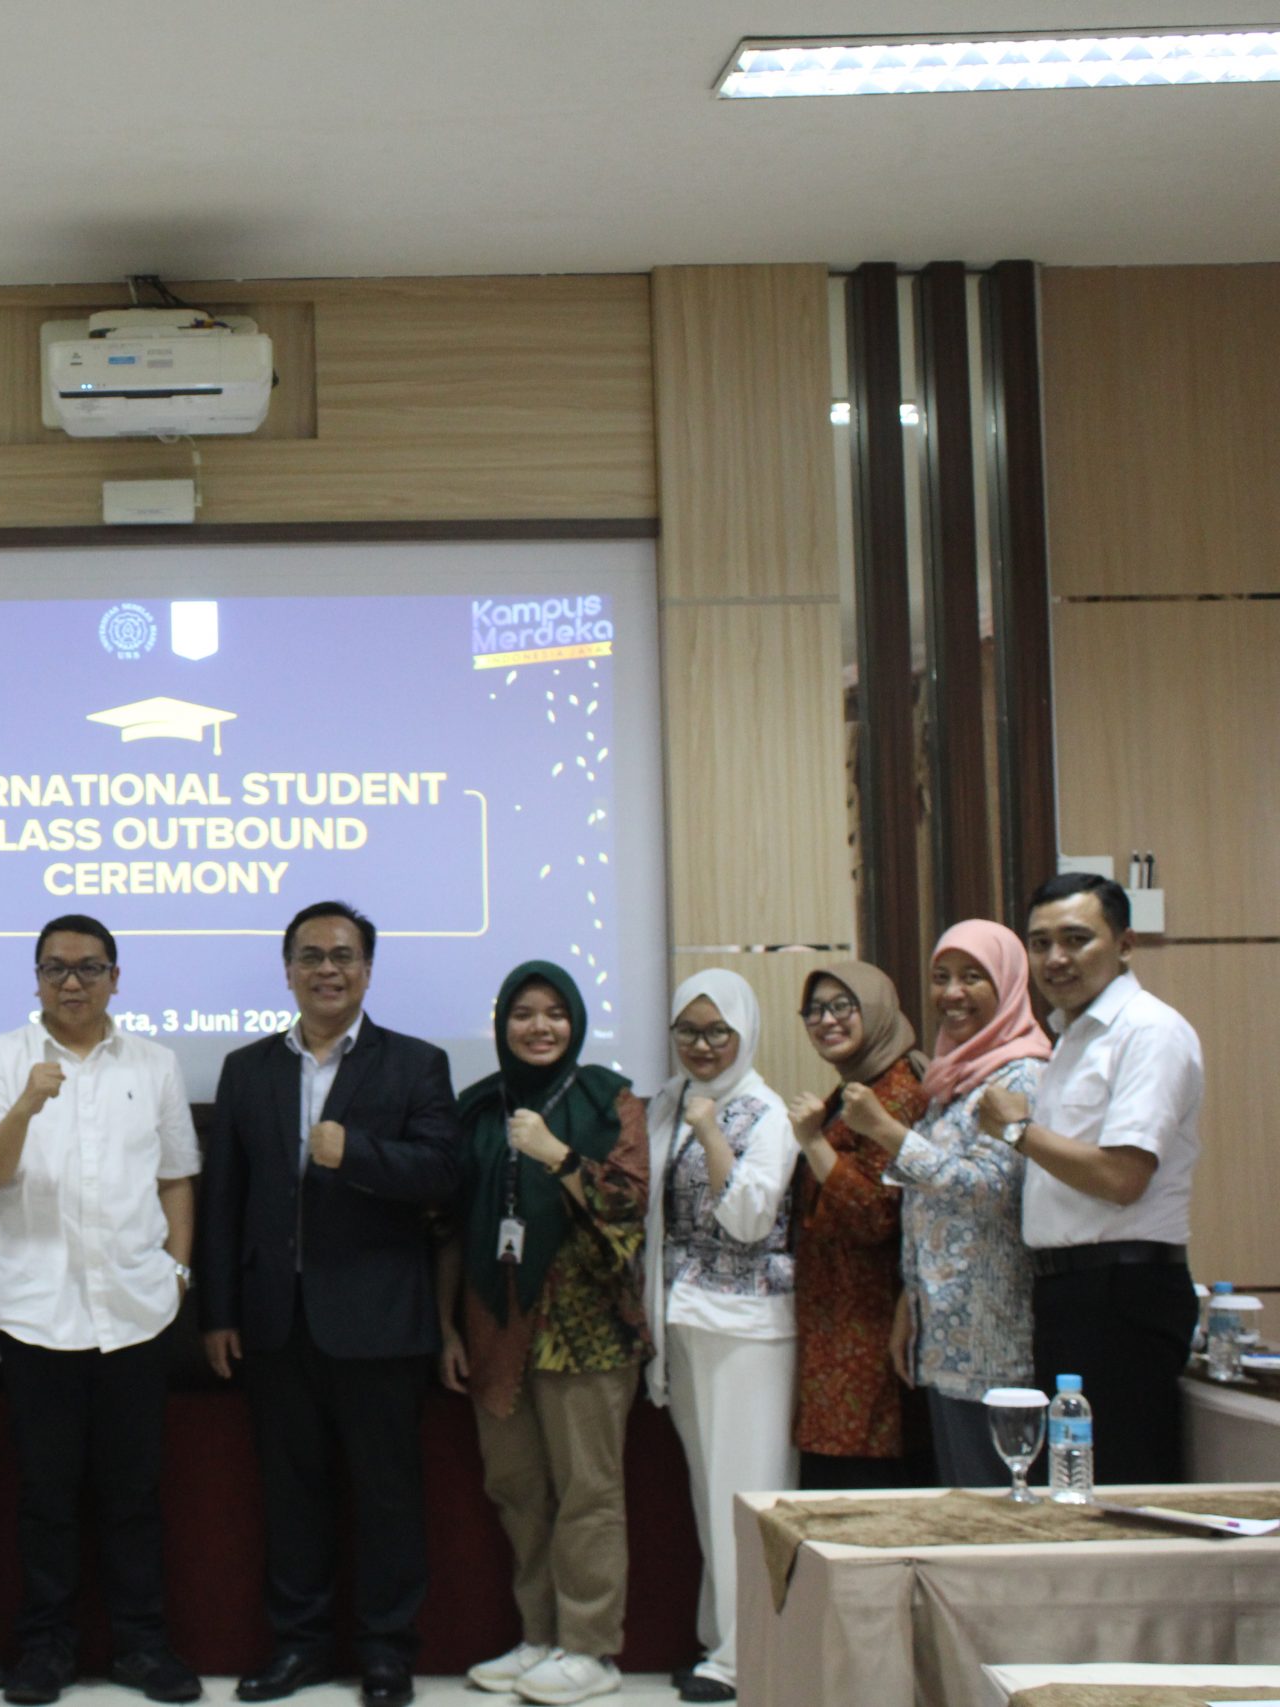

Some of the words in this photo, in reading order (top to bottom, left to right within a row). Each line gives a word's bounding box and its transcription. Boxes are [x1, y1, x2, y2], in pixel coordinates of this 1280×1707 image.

[472, 595, 602, 627] Kampus
[472, 618, 613, 652] Merdeka
[241, 772, 448, 806] STUDENT
[112, 816, 369, 851] OUTBOUND
[42, 860, 290, 896] CEREMONY
[162, 1008, 180, 1032] 3
[183, 1008, 239, 1032] Juni
